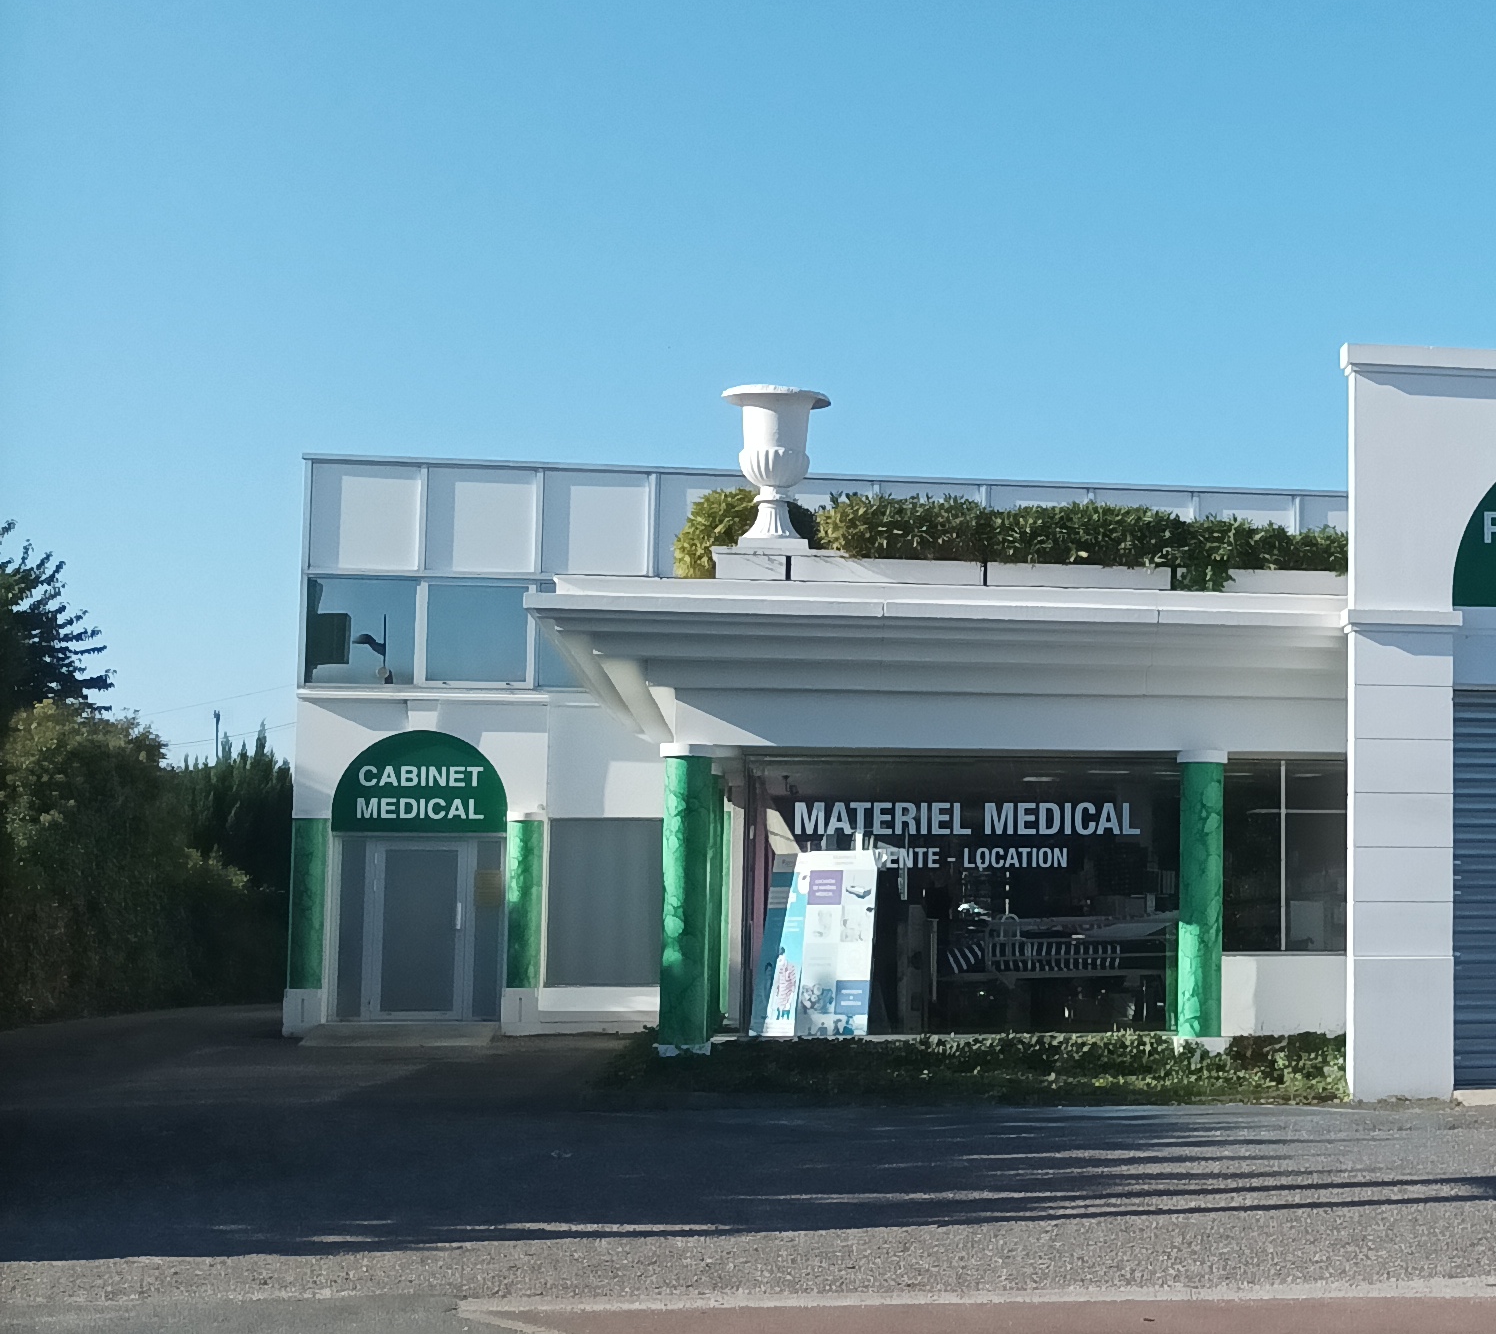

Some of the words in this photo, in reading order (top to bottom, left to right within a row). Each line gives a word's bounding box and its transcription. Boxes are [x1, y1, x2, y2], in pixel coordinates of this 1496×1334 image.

[358, 765, 484, 787] CABINET
[356, 797, 485, 820] MEDICAL
[794, 801, 972, 835] MATERIEL
[984, 802, 1141, 835] MEDICAL
[872, 847, 940, 868] VENTE
[963, 847, 1068, 868] LOCATION
